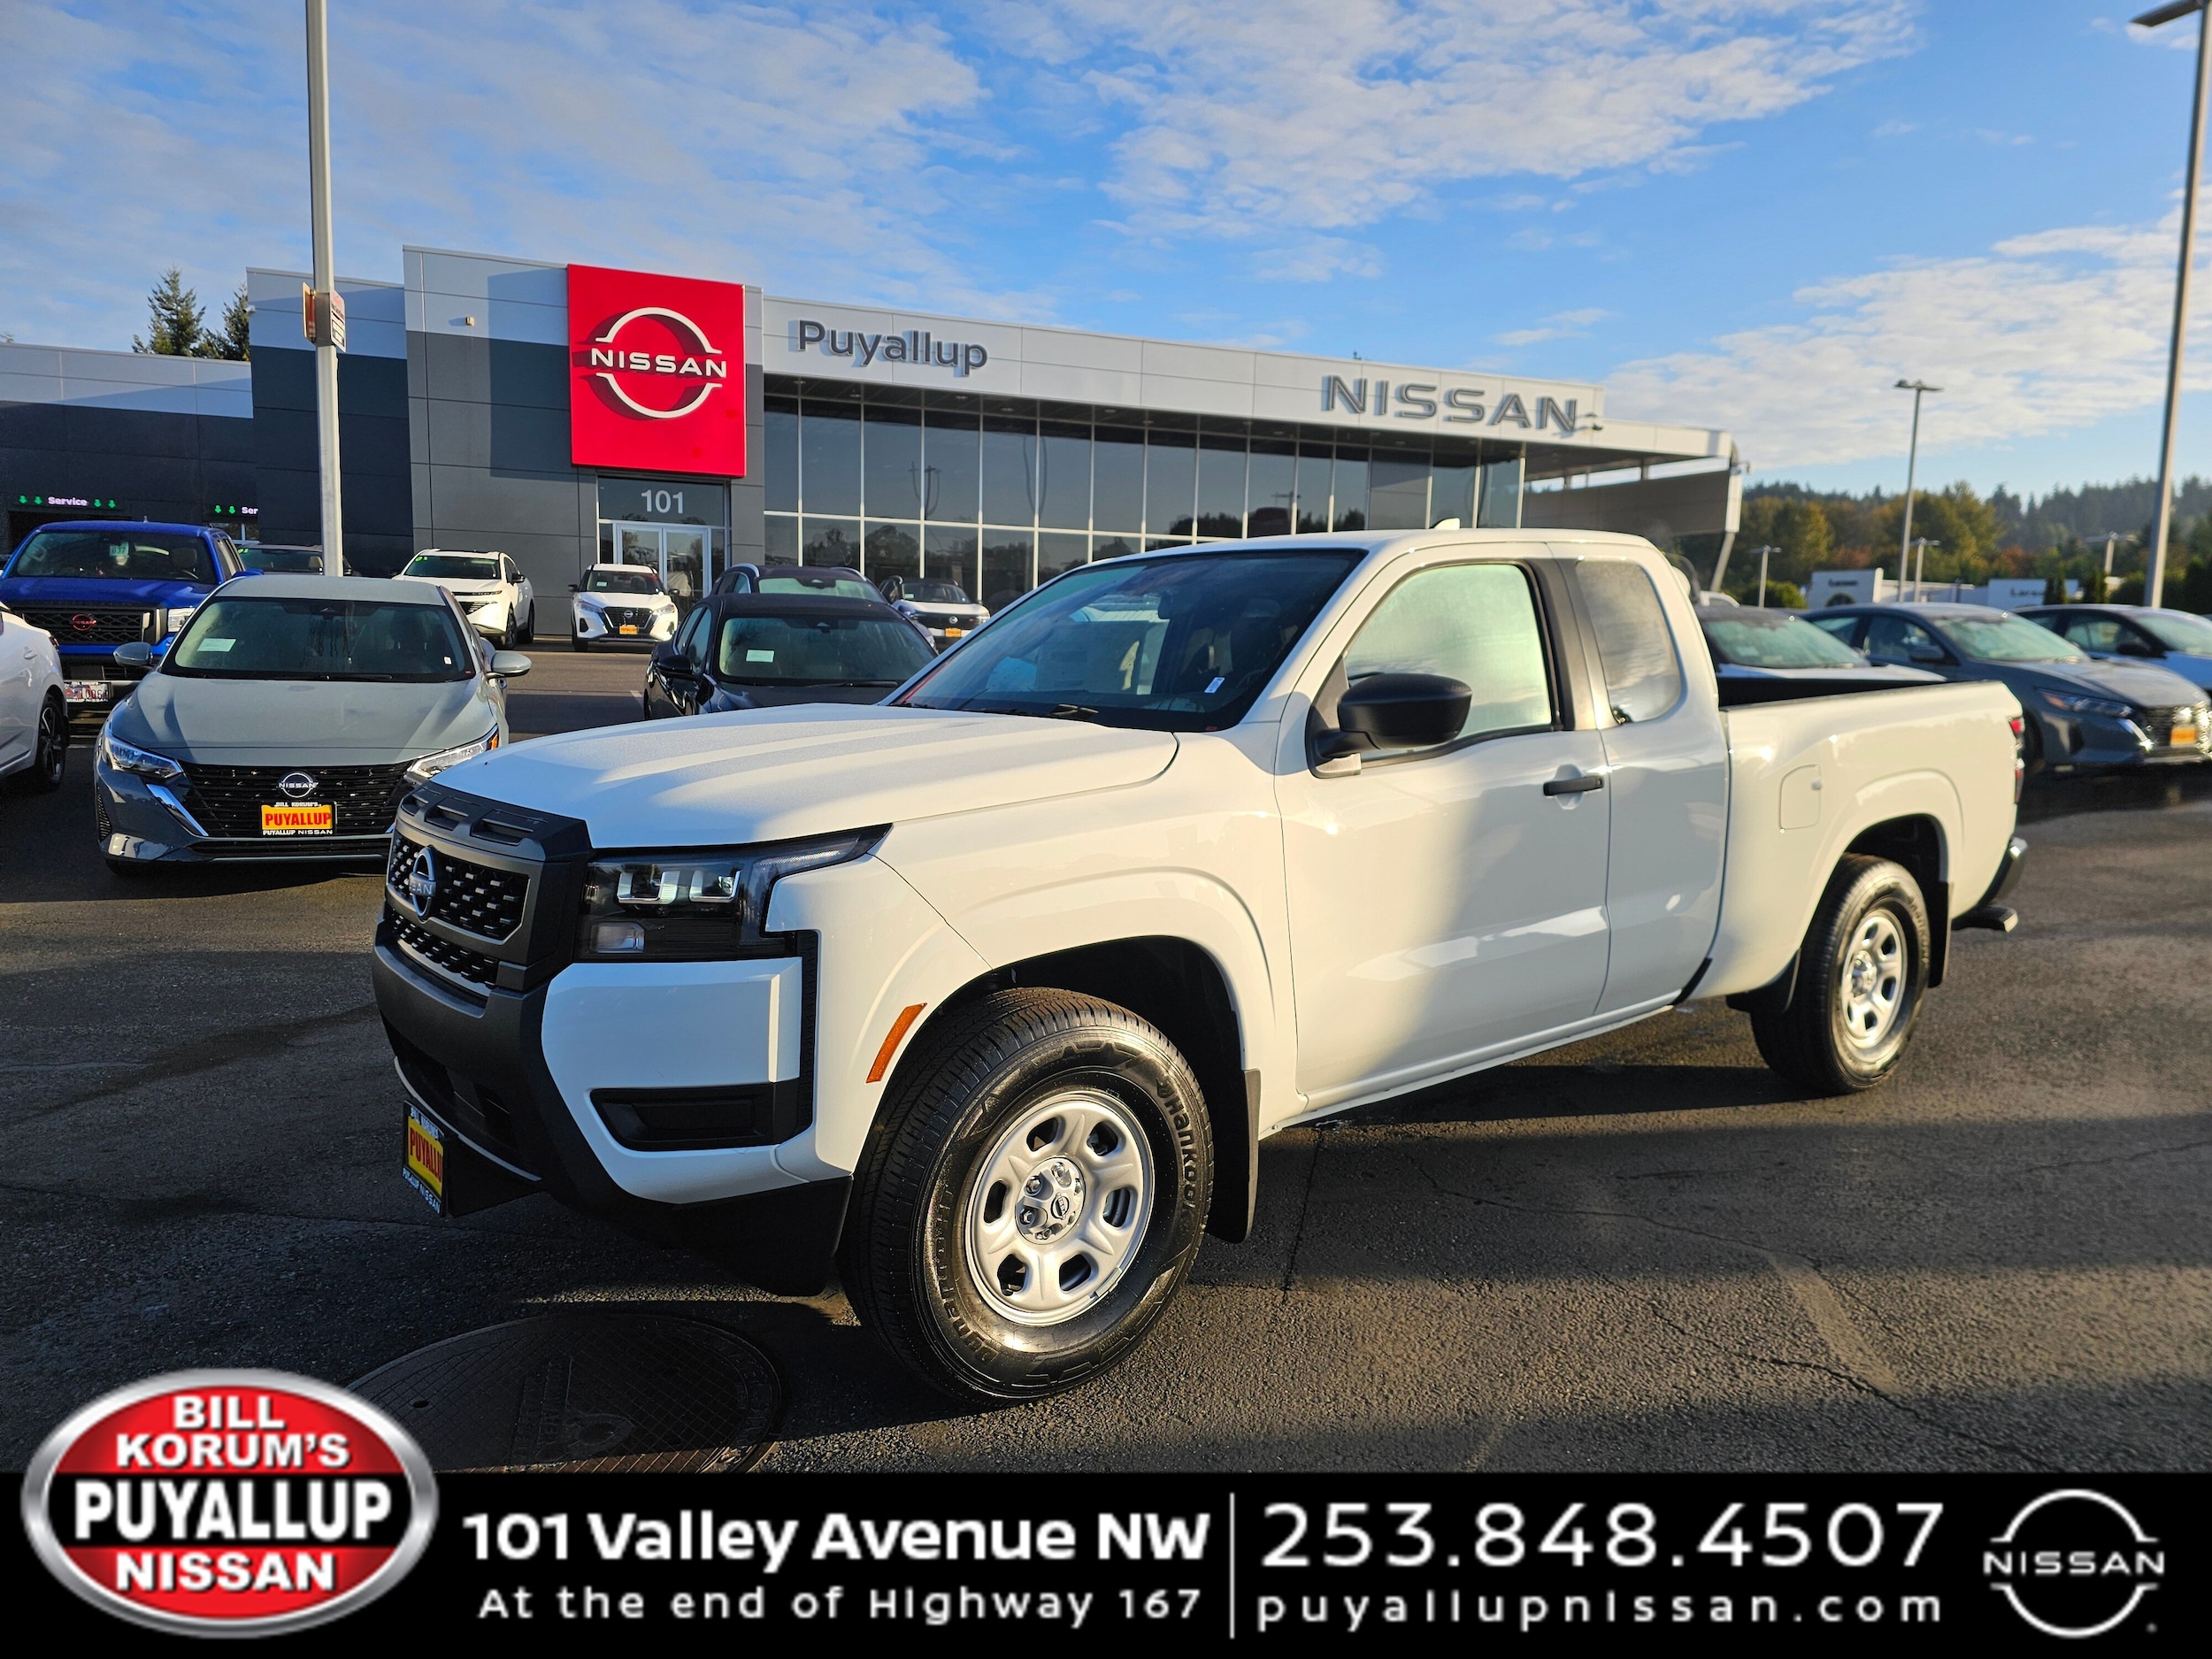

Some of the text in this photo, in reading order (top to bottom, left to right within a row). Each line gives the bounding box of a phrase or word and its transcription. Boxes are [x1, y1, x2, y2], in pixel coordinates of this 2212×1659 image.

[798, 319, 988, 376] Puyallup
[591, 347, 727, 379] NISSAN
[1326, 374, 1578, 433] NISSAN
[48, 496, 88, 507] Service
[641, 488, 684, 514] 101
[265, 812, 332, 826] PUYALLUP
